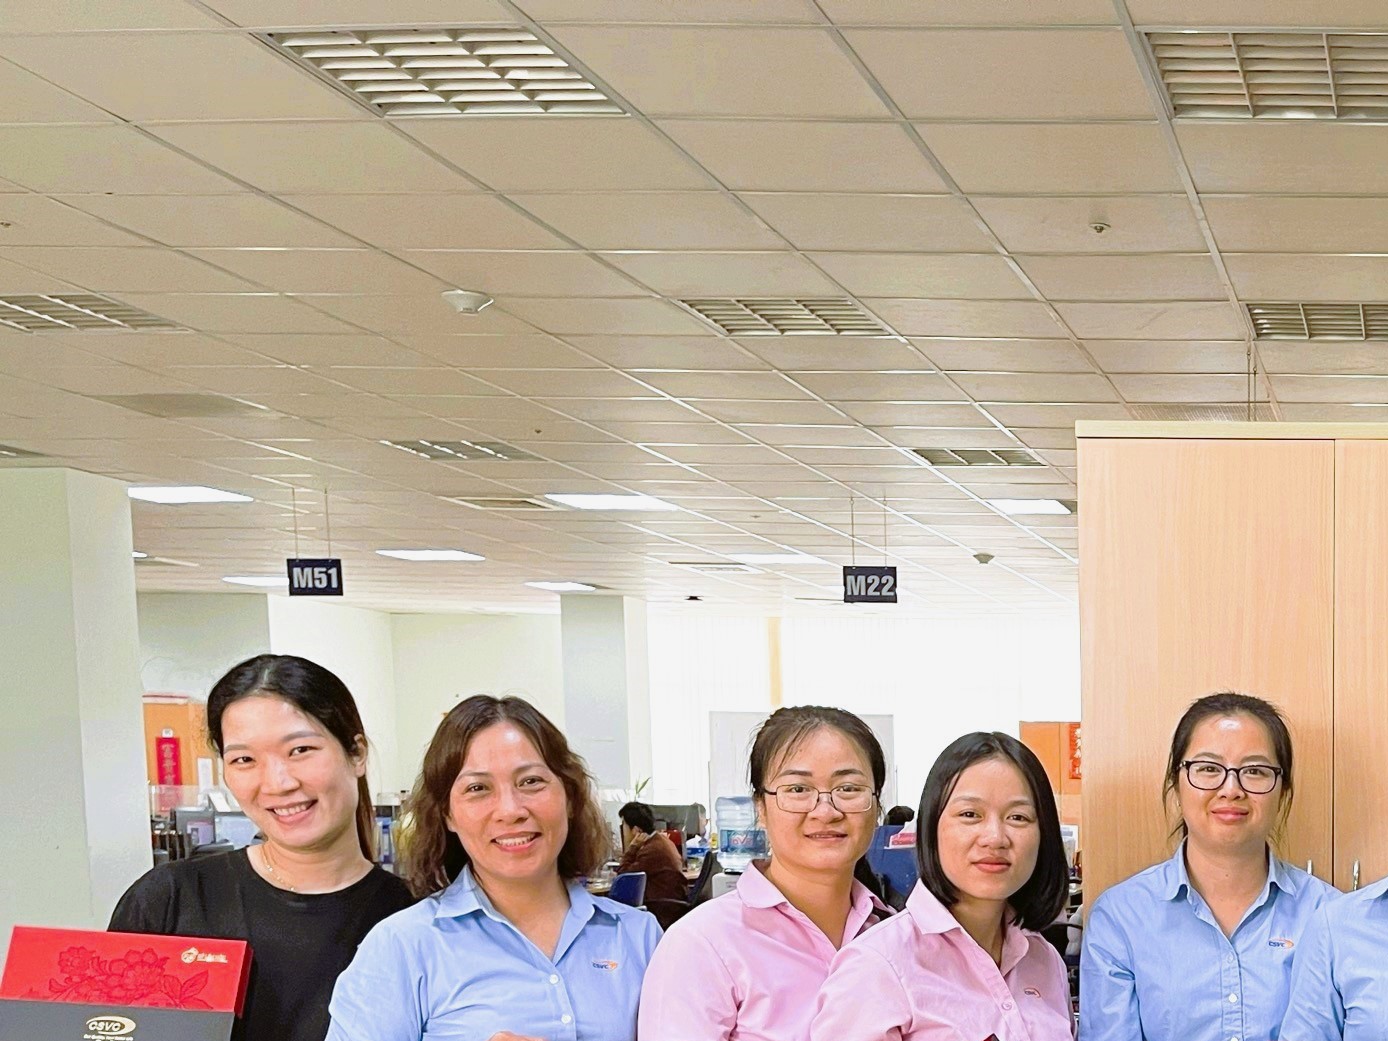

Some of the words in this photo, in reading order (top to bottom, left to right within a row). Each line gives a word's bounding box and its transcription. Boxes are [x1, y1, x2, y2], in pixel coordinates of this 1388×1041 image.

[292, 567, 338, 588] M51
[846, 575, 895, 596] M22
[88, 1021, 121, 1031] CSVC
